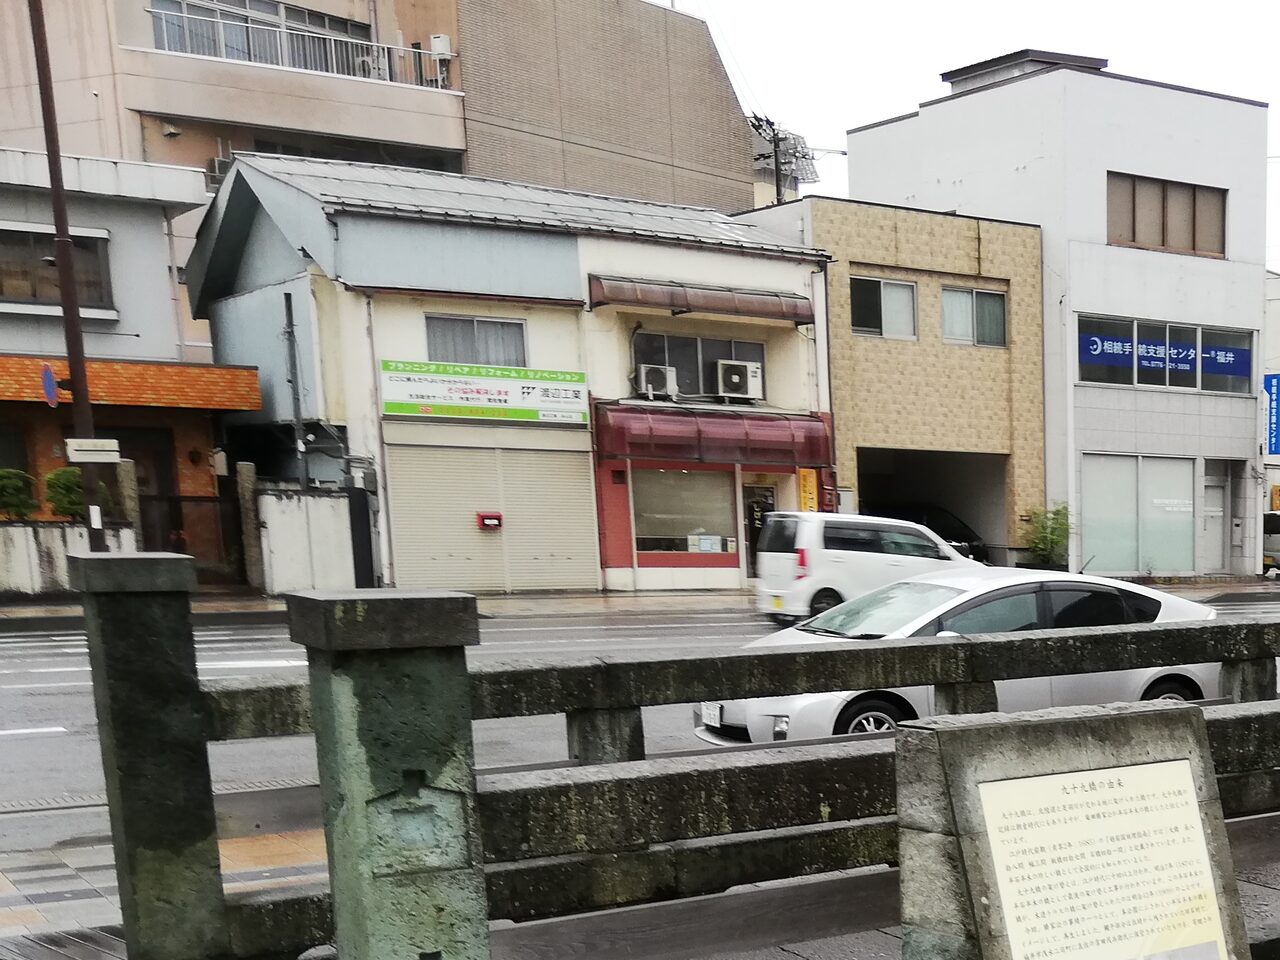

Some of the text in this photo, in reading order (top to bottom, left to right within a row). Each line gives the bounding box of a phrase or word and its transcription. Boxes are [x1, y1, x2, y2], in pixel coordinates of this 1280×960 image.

[1061, 777, 1124, 795] 九十九橋の由来
